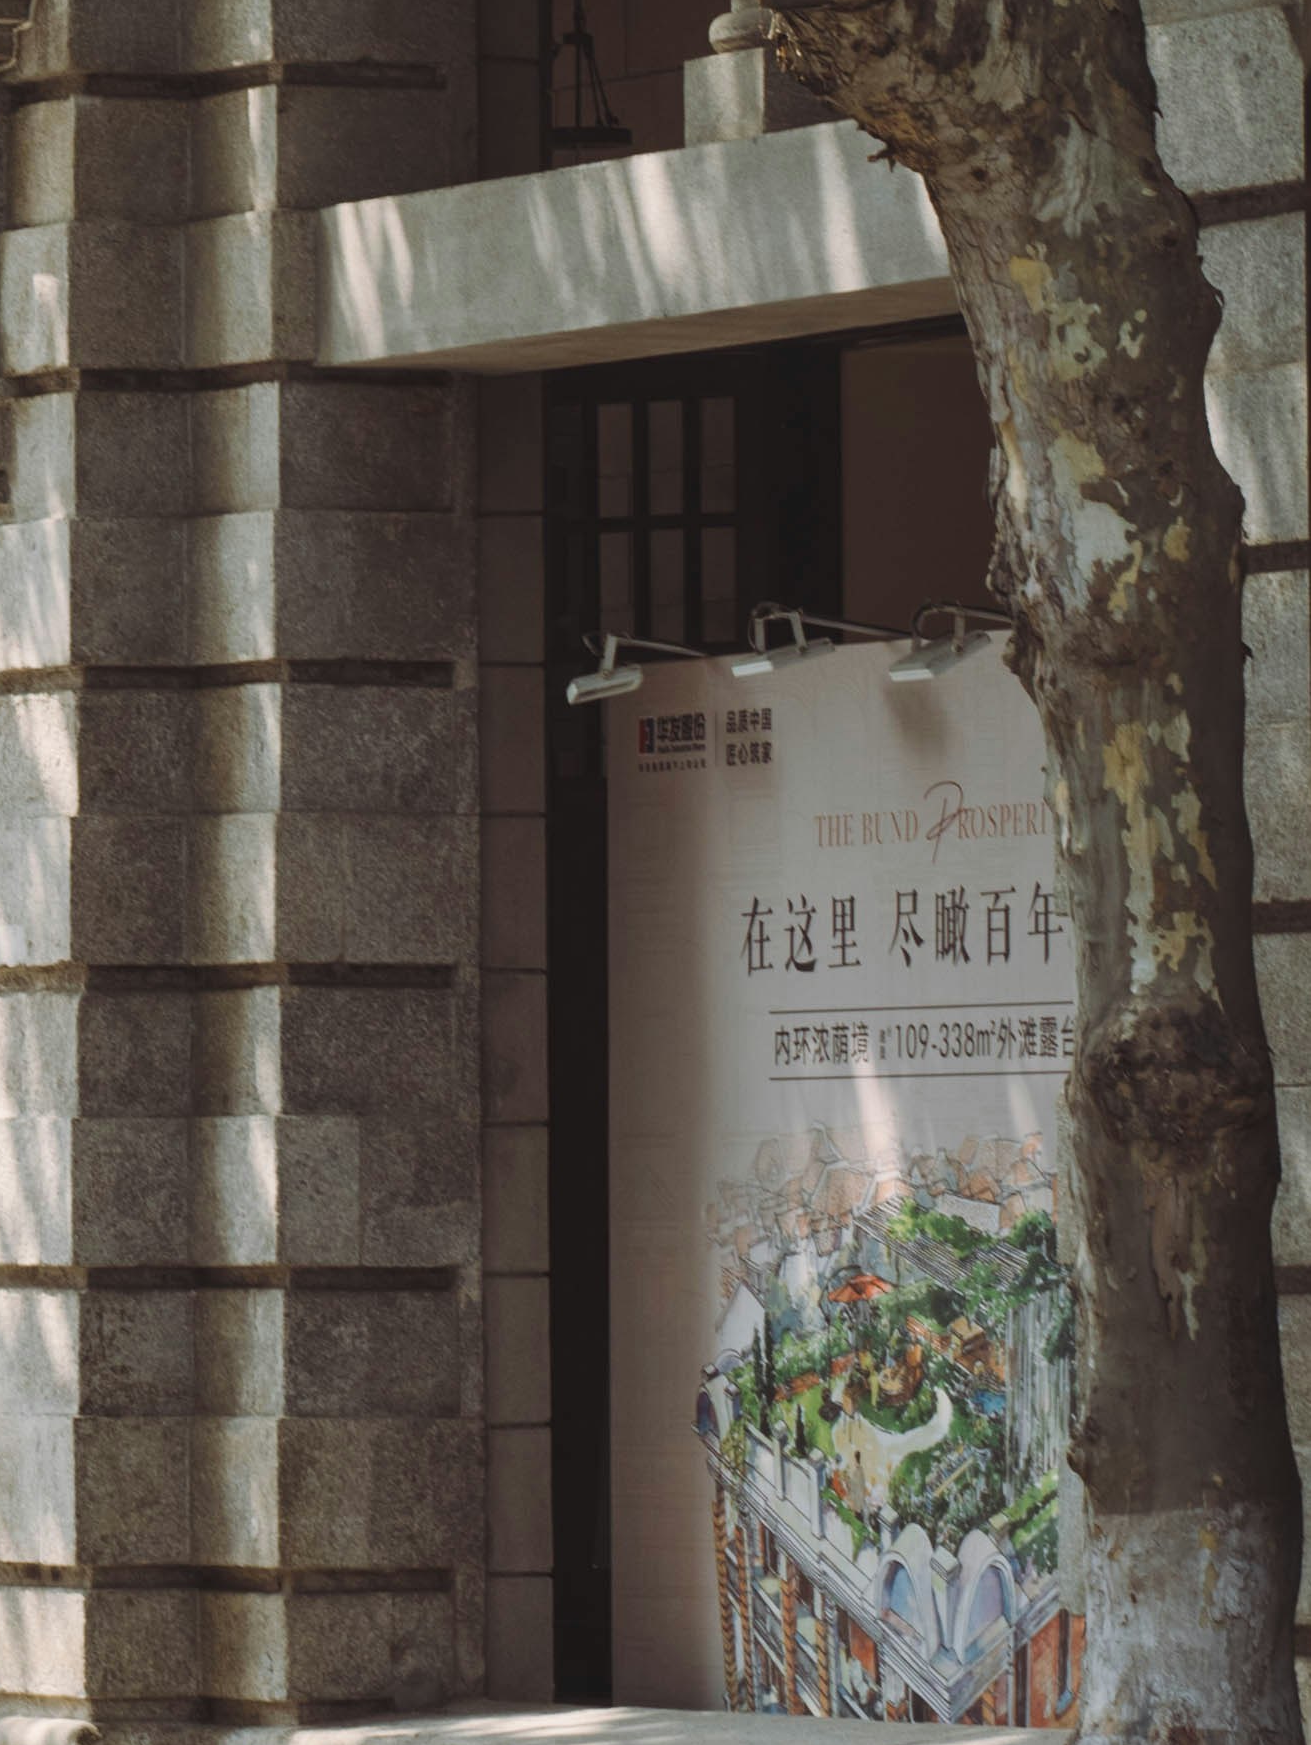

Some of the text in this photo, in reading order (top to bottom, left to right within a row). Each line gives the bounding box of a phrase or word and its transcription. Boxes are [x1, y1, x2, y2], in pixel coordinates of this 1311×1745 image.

[814, 814, 855, 848] THE
[861, 809, 920, 844] BUND
[740, 881, 1069, 978] 在这里 尽瞰百年
